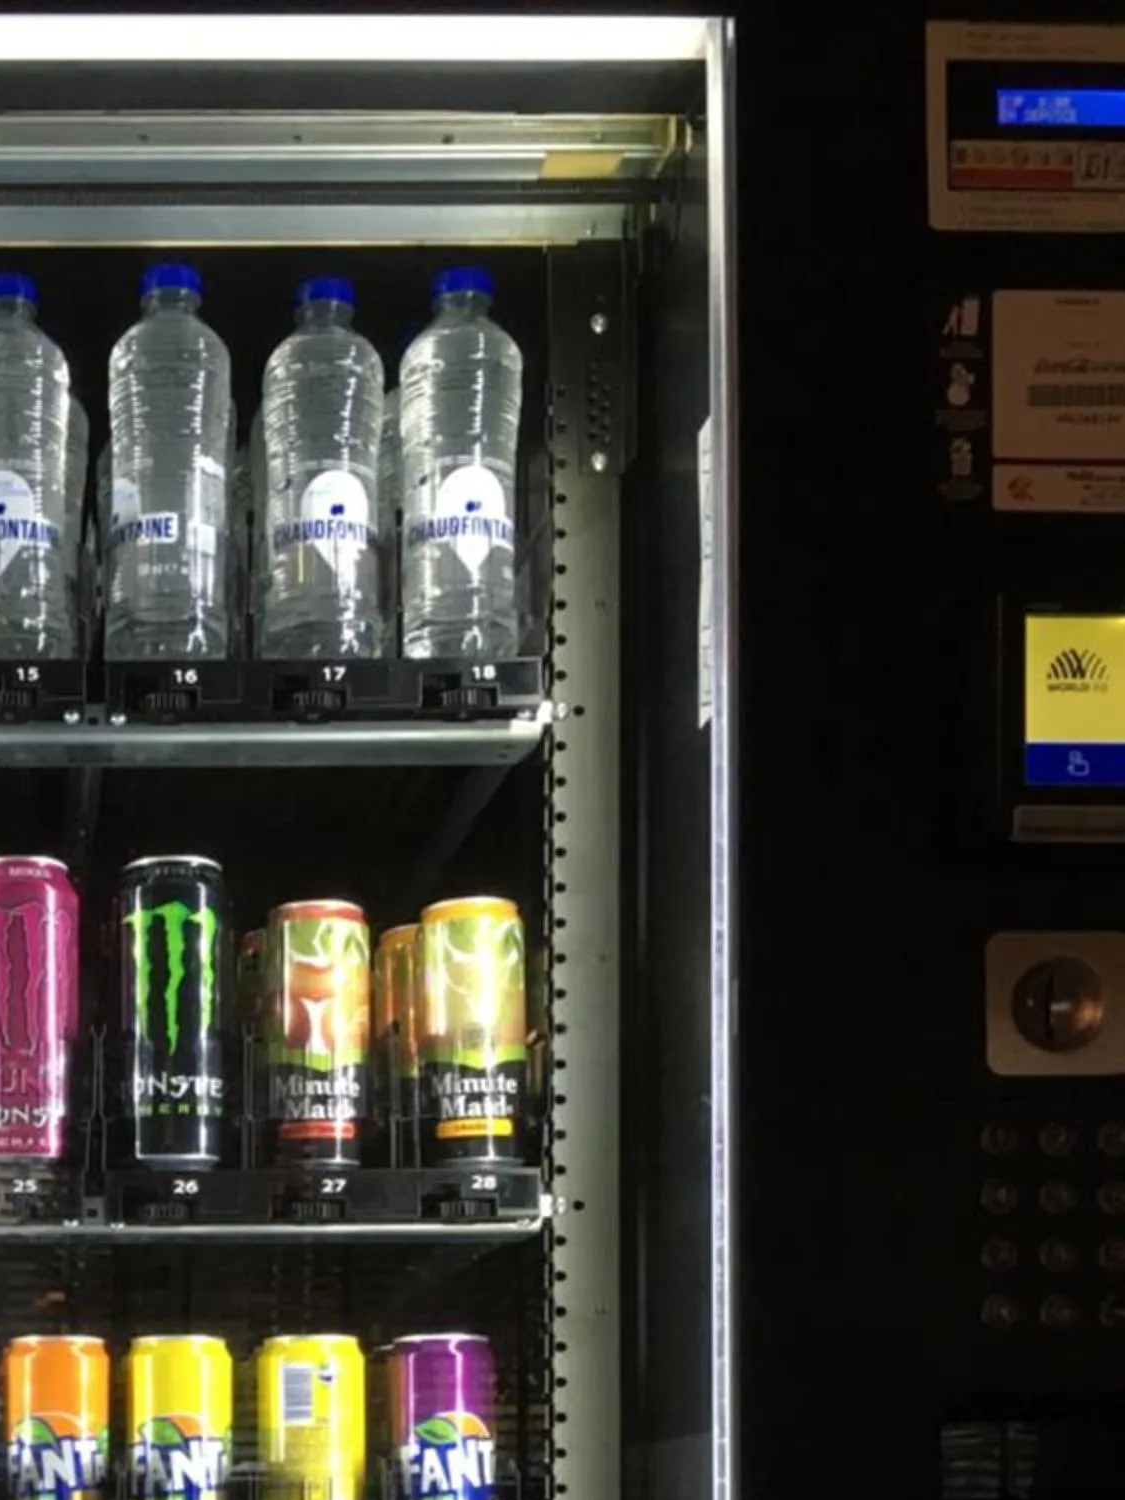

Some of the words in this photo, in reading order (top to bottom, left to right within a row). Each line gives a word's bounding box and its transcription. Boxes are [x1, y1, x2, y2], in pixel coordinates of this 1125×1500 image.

[16, 666, 40, 682] 15
[174, 668, 198, 684] 16
[323, 666, 346, 681] 17
[472, 664, 496, 680] 18
[275, 1072, 361, 1098] Minute
[432, 1071, 518, 1097] Minute
[441, 1096, 510, 1119] Maid
[12, 1178, 38, 1193] 25
[173, 1179, 199, 1194] 26
[322, 1178, 347, 1193] 27
[471, 1174, 497, 1190] 28
